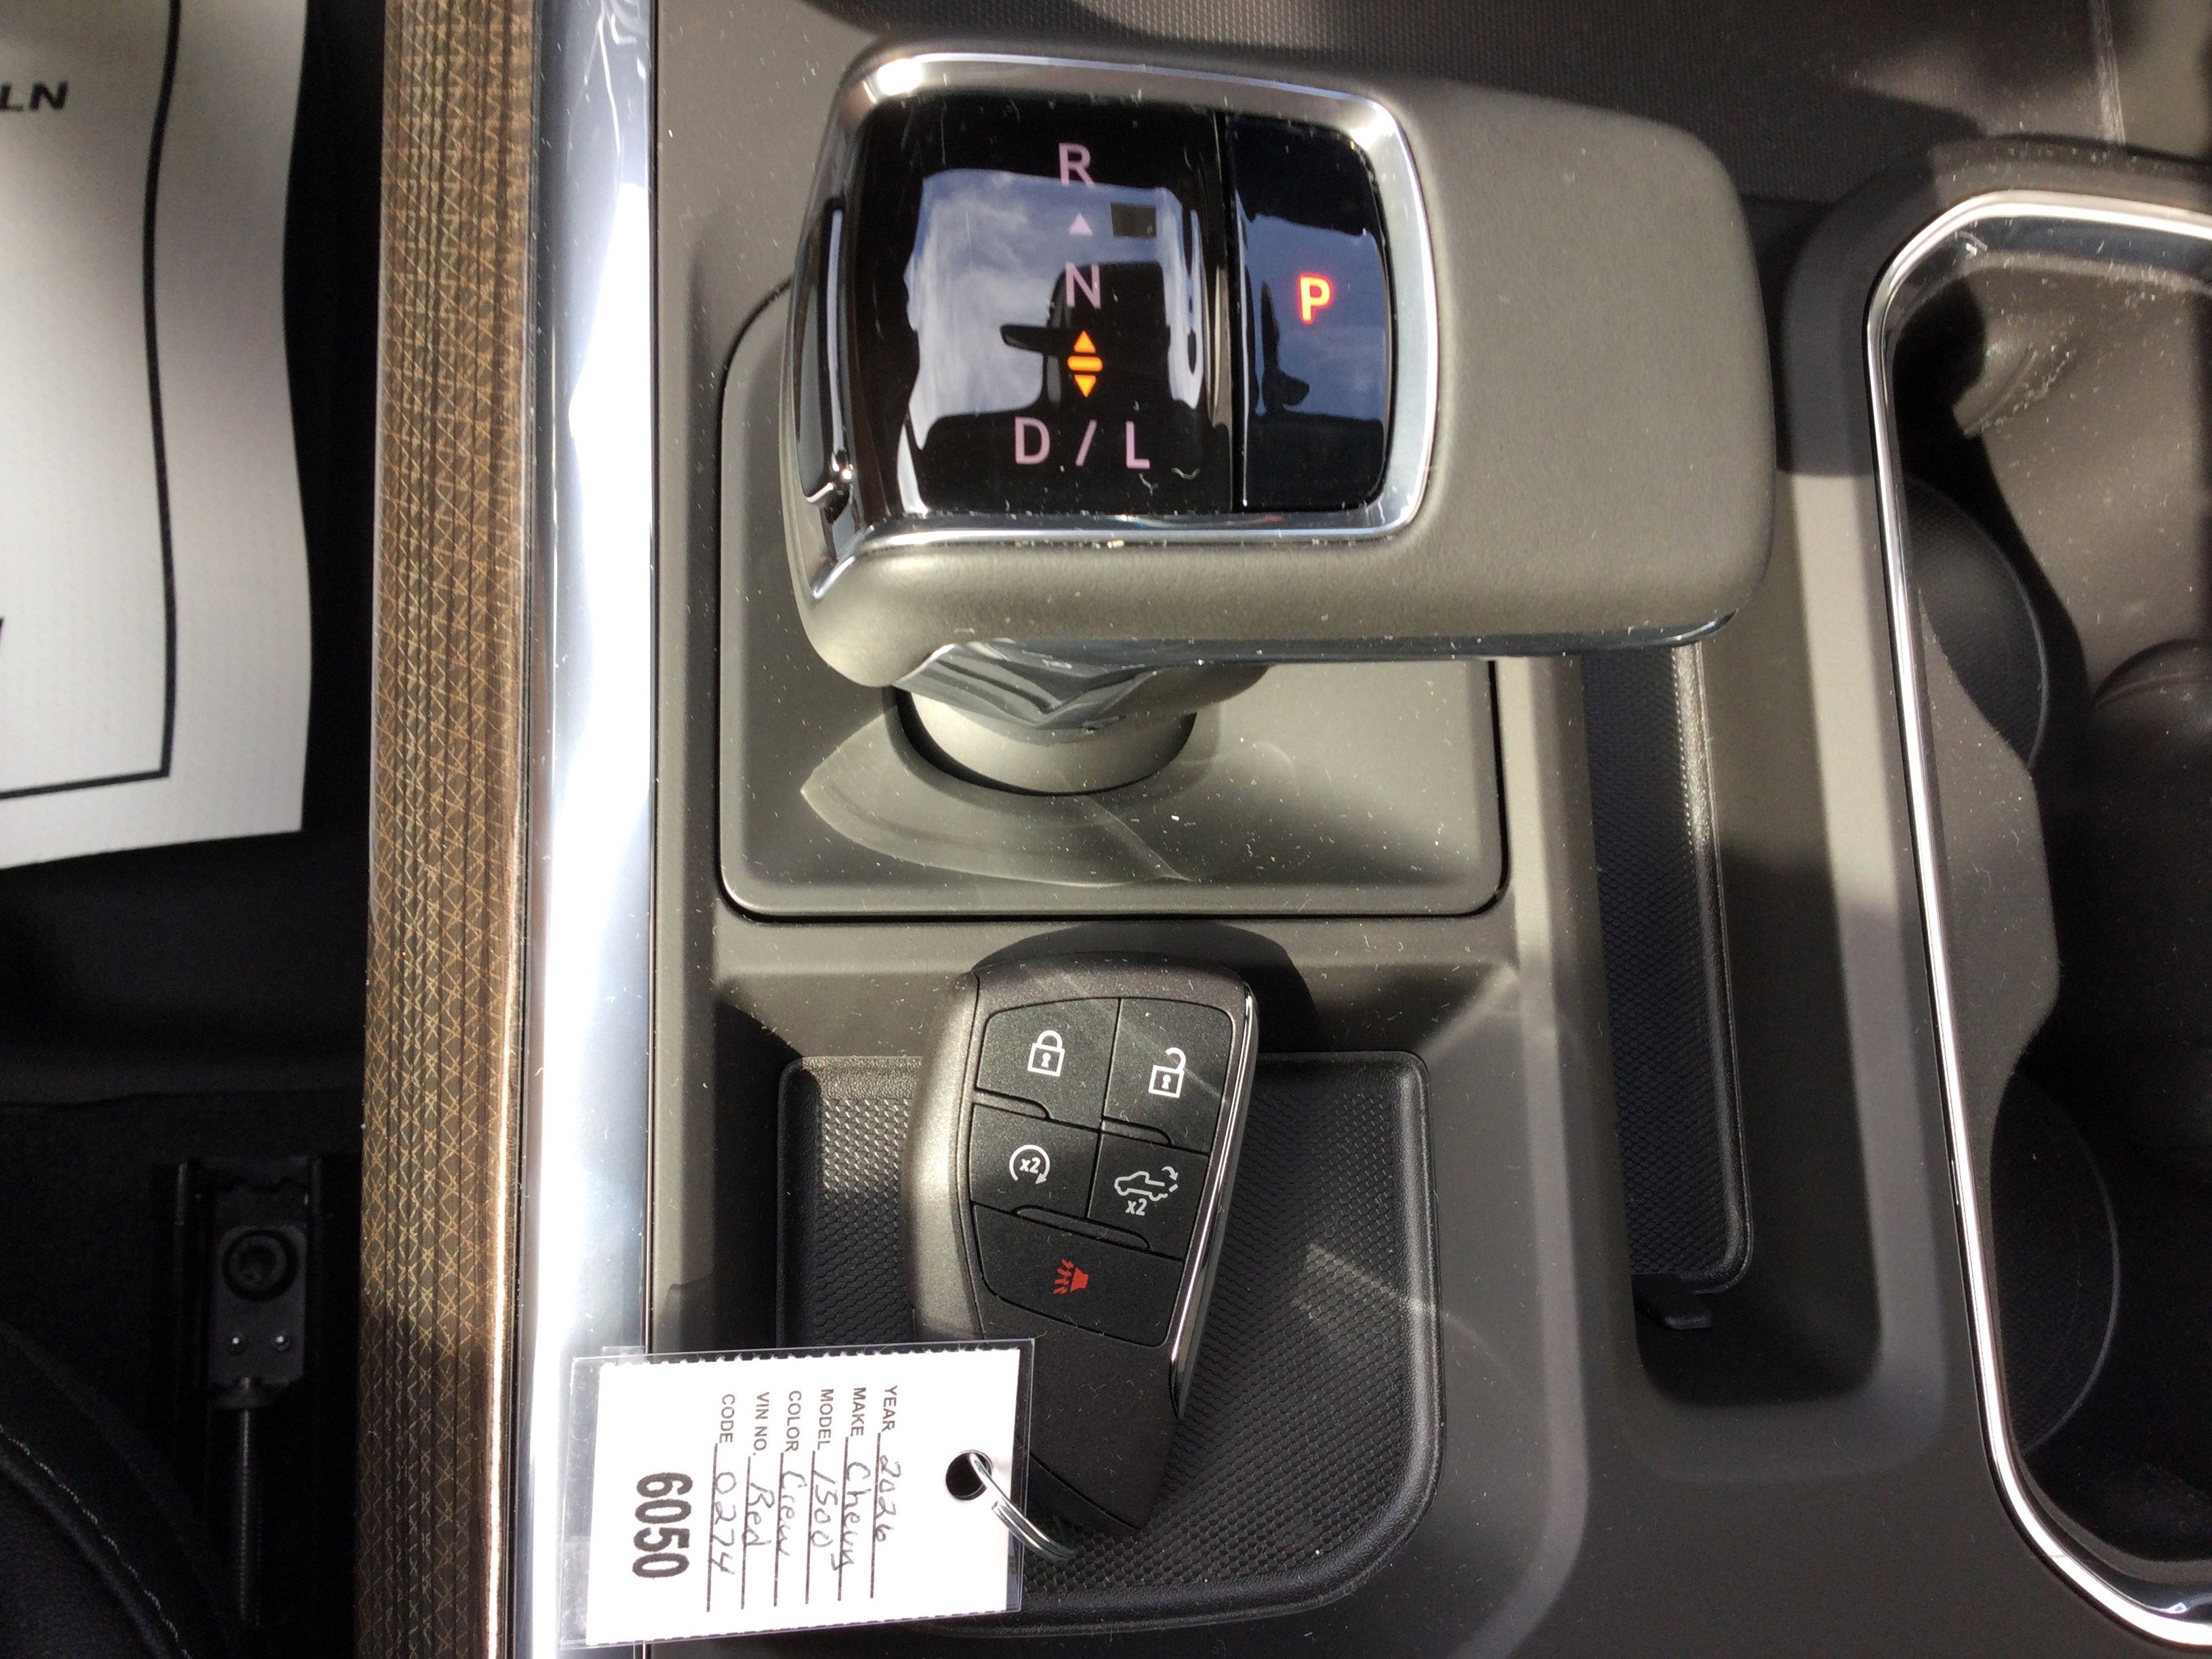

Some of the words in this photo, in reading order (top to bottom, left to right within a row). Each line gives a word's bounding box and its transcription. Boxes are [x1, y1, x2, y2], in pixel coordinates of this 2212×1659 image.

[1059, 143, 1093, 185] R
[1065, 263, 1101, 308] N
[1299, 275, 1331, 323] P
[1015, 418, 1050, 464] D
[1126, 421, 1150, 469] L
[718, 1393, 736, 1444] CODE
[754, 1391, 770, 1424] VIN
[785, 1390, 802, 1452] COLOR
[818, 1389, 835, 1450] MODEL
[851, 1387, 867, 1437] MAKE
[882, 1385, 899, 1432] YEAR
[752, 1429, 768, 1456] NO.
[708, 1471, 739, 1575] 0274
[743, 1481, 776, 1549] Red
[873, 1453, 901, 1542] 2026
[632, 1472, 694, 1580] 6050
